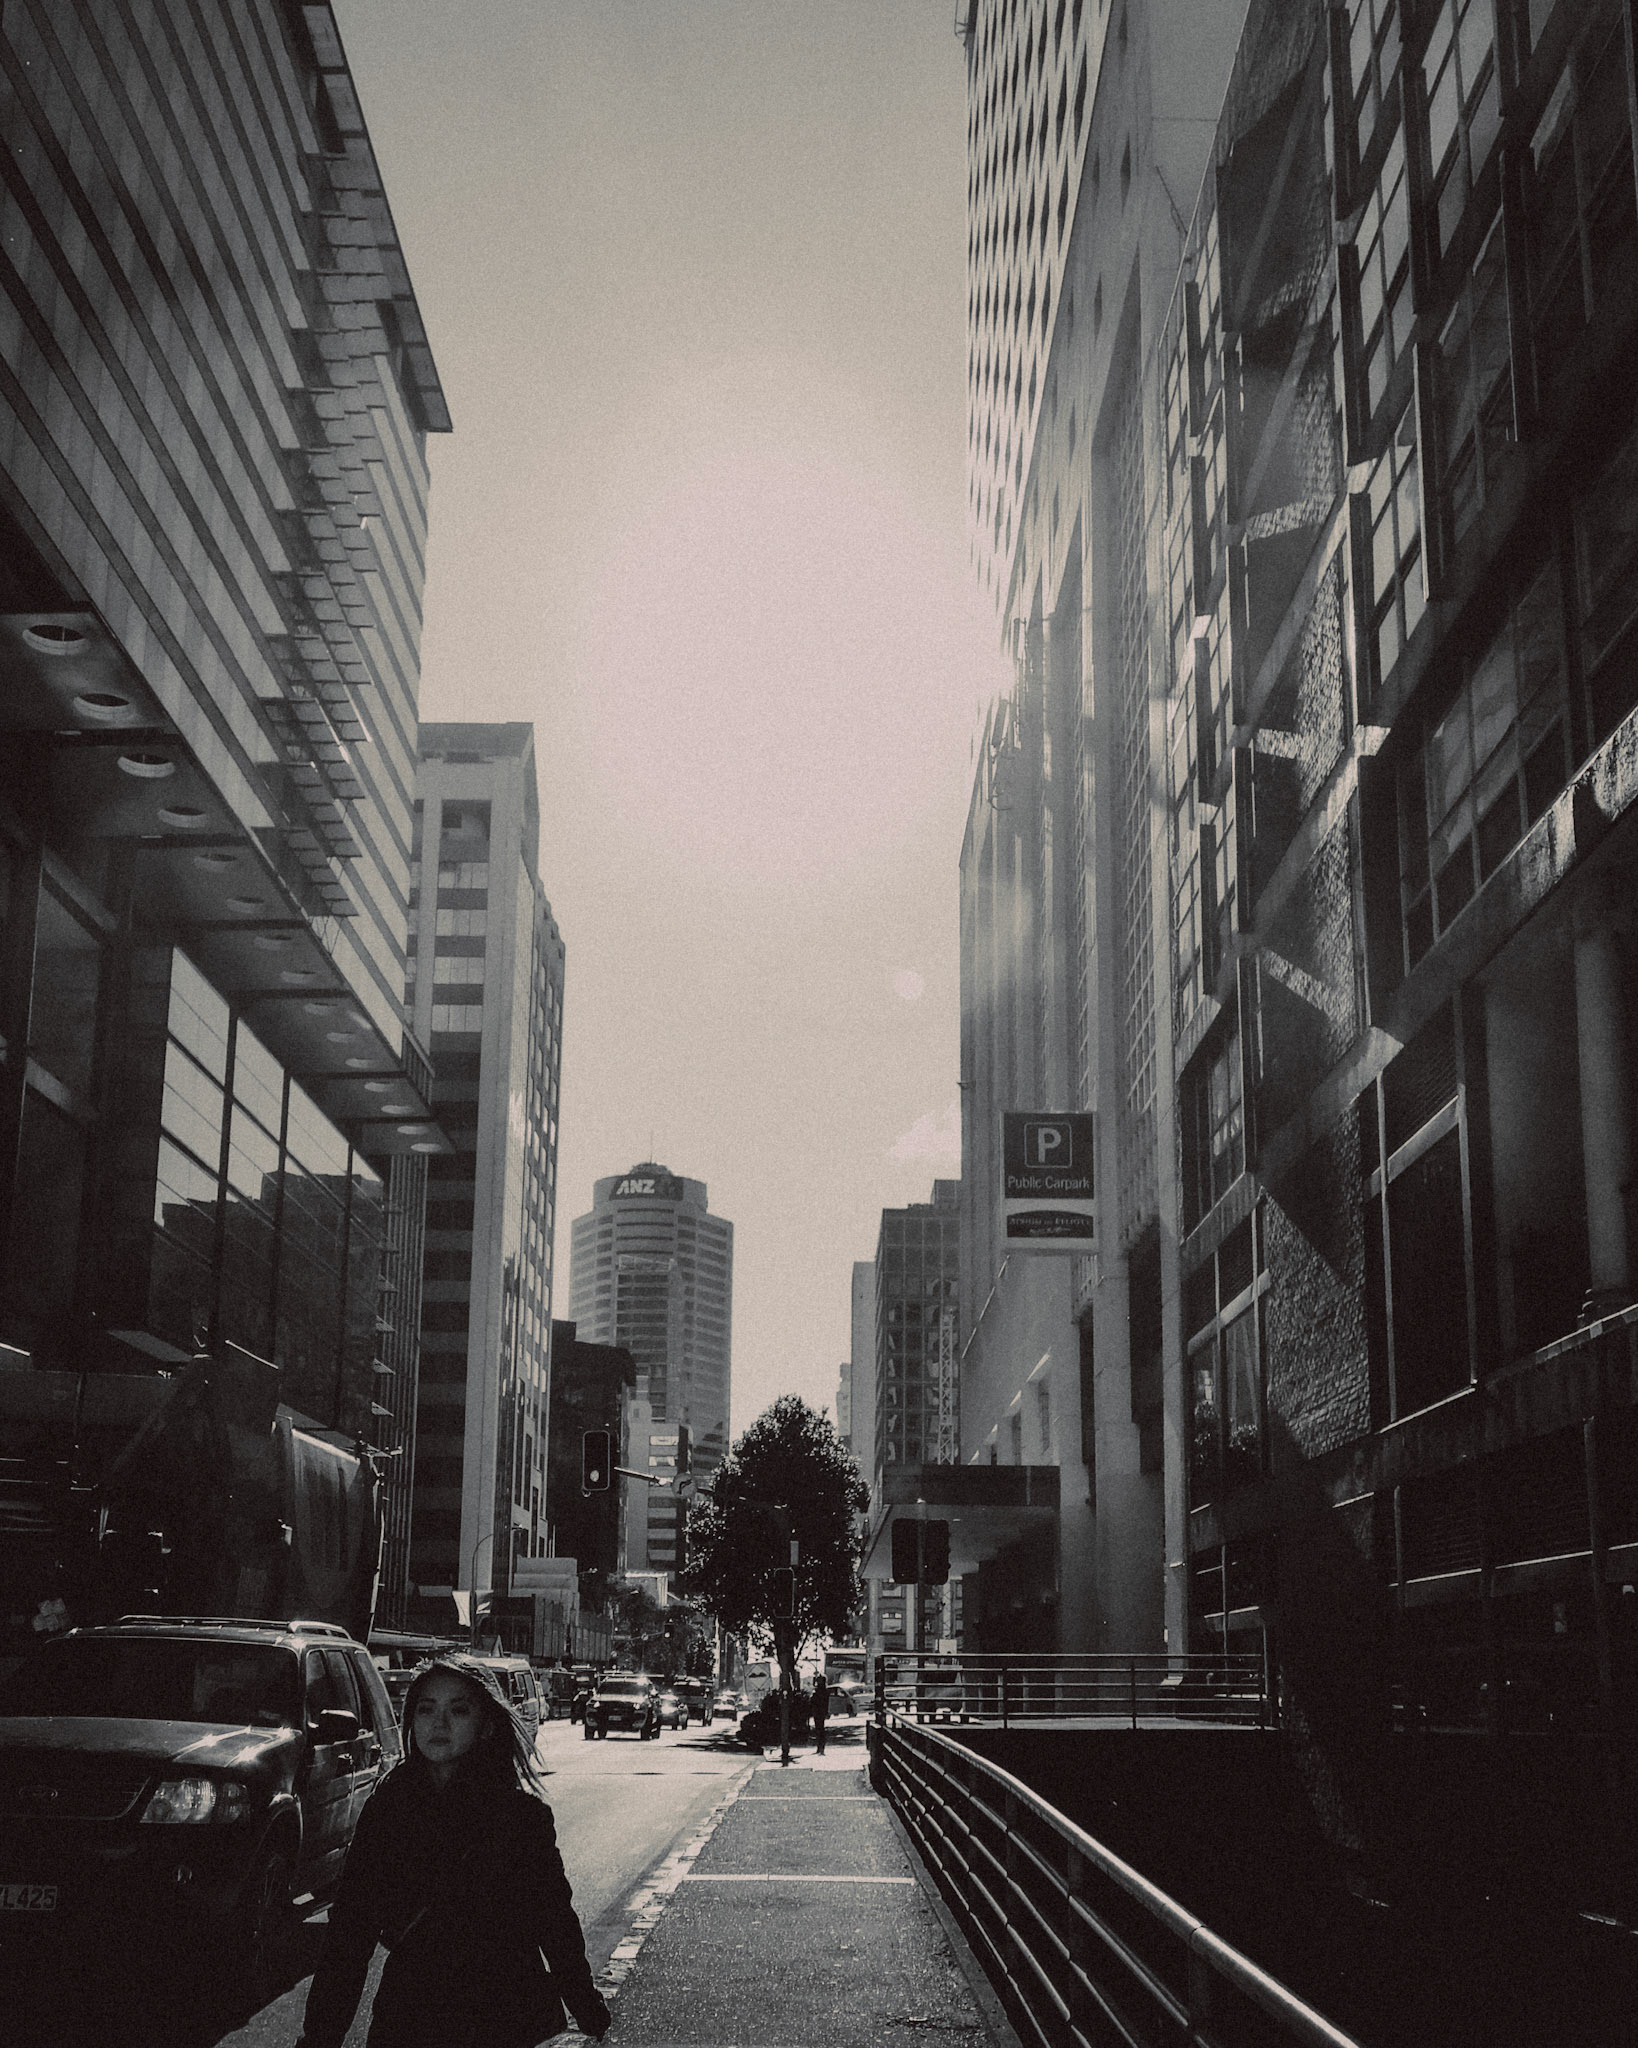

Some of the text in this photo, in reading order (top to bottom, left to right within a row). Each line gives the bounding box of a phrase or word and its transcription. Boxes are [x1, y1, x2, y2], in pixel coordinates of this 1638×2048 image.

[1038, 1127, 1061, 1163] P
[616, 1179, 655, 1195] ANZ
[1007, 1175, 1090, 1191] Public Carpark
[0, 1887, 56, 1909] L425
